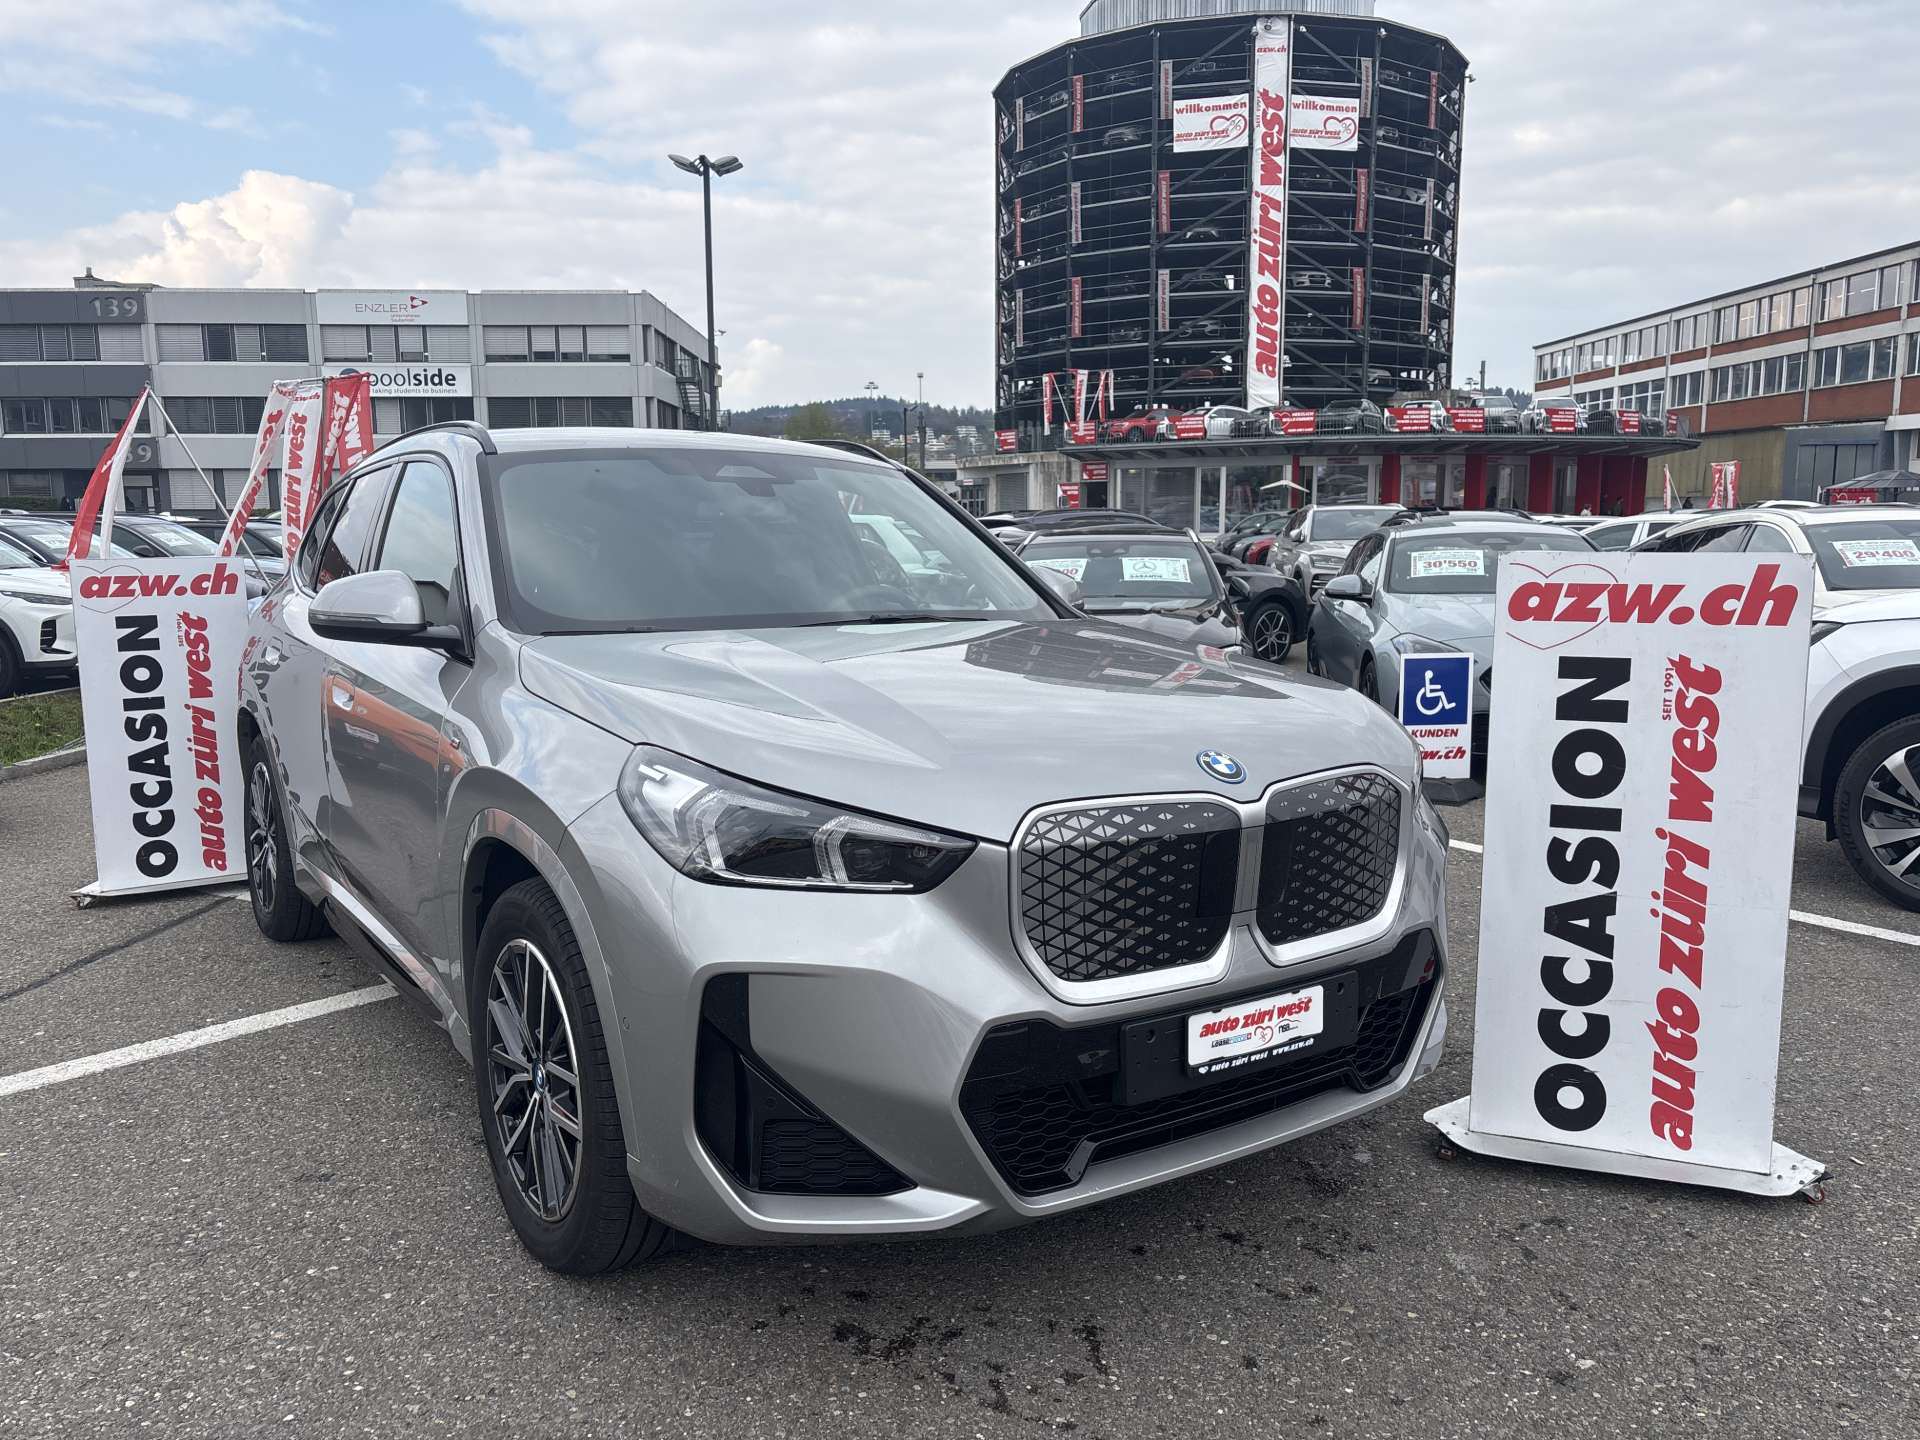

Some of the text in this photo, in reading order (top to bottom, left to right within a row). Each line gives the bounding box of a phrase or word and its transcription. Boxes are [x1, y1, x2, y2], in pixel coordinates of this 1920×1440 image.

[1257, 45, 1287, 53] azw.ch
[1175, 102, 1247, 114] willkommen
[1292, 100, 1357, 112] willkommen
[1252, 88, 1285, 378] auto züri west
[90, 299, 138, 317] 139
[355, 303, 408, 312] ENZLER
[372, 387, 392, 395] taking
[288, 412, 307, 469] west
[283, 472, 301, 532] züri
[1423, 560, 1478, 569] 30'550
[1856, 550, 1916, 559] 29'400
[80, 563, 238, 598] azw.ch
[1507, 563, 1799, 627] azw.ch
[1662, 667, 1674, 721] SEIT 1991
[115, 615, 179, 878] OCCASION
[177, 611, 227, 871] auto züri west
[1412, 728, 1458, 738] KUNDEN
[1534, 656, 1632, 1131] OCCASION
[1643, 653, 1722, 1151] auto züri west
[1199, 996, 1312, 1038] auto züri west
[1210, 1061, 1230, 1072] auto
[1231, 1056, 1249, 1067] züri
[1250, 1050, 1269, 1062] west
